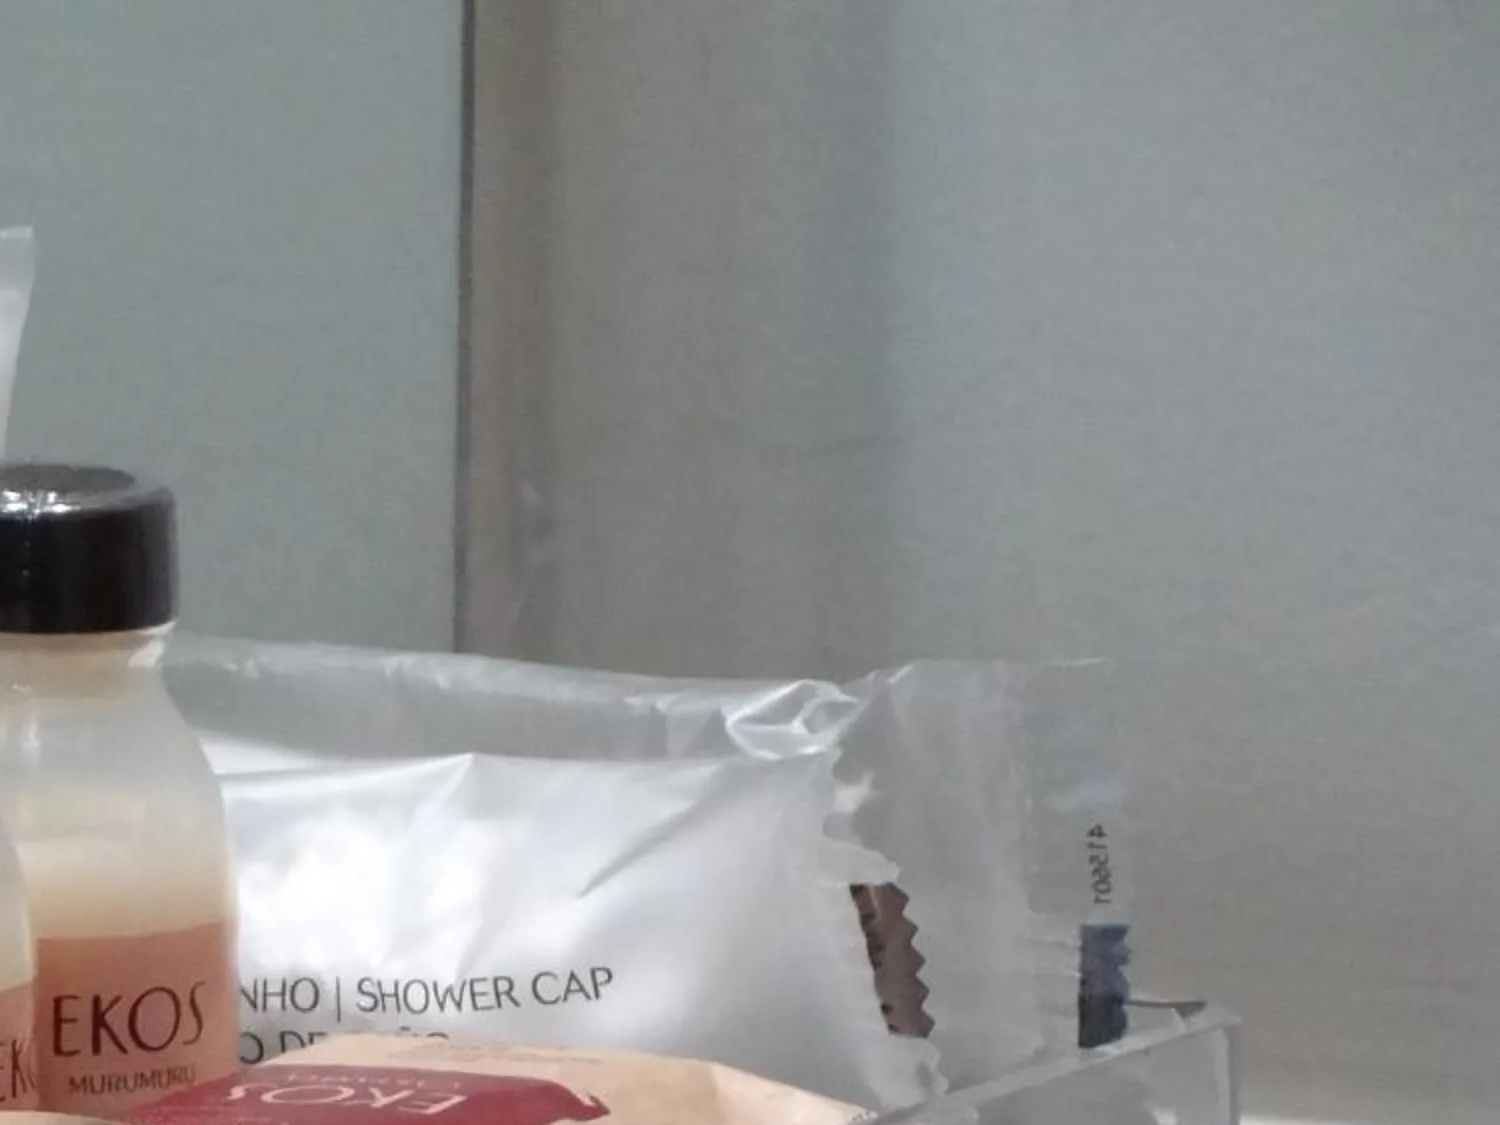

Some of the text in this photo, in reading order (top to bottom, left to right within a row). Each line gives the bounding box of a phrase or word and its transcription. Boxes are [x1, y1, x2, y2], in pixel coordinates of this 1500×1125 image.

[356, 976, 521, 1015] SHOWER
[532, 966, 614, 1006] CAP
[53, 980, 206, 1058] EKOS
[228, 1082, 468, 1115] EKOS
